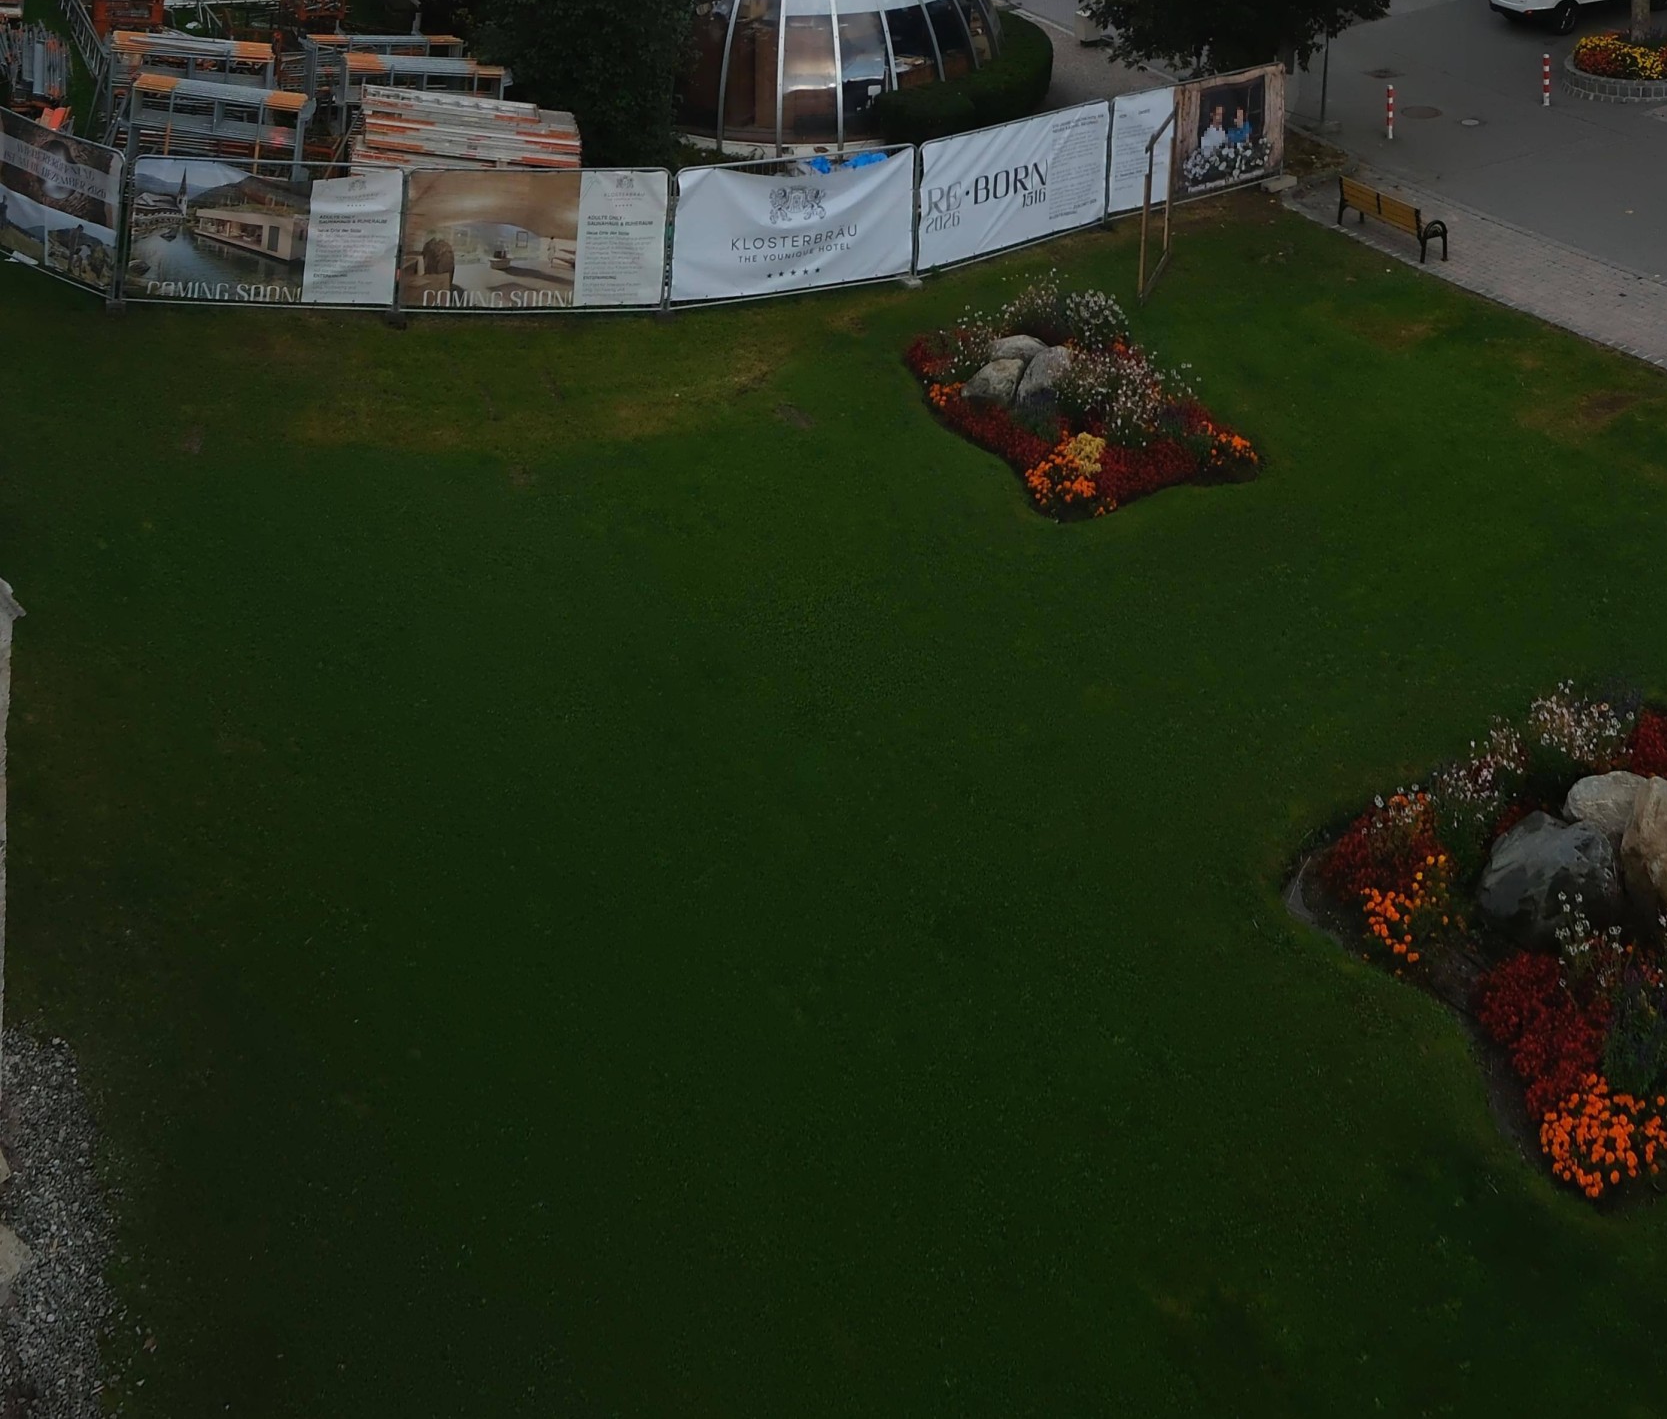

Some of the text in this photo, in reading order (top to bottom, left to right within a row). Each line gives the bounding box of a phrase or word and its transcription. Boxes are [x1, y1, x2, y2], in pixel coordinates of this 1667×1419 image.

[1022, 187, 1046, 208] 1516
[925, 210, 960, 234] 2026
[731, 224, 857, 251] KLOSTERBRÄU
[738, 242, 851, 263] THE YOUNIQUE HOTEL
[146, 281, 229, 300] COMING
[422, 289, 574, 307] COMING SOON!
